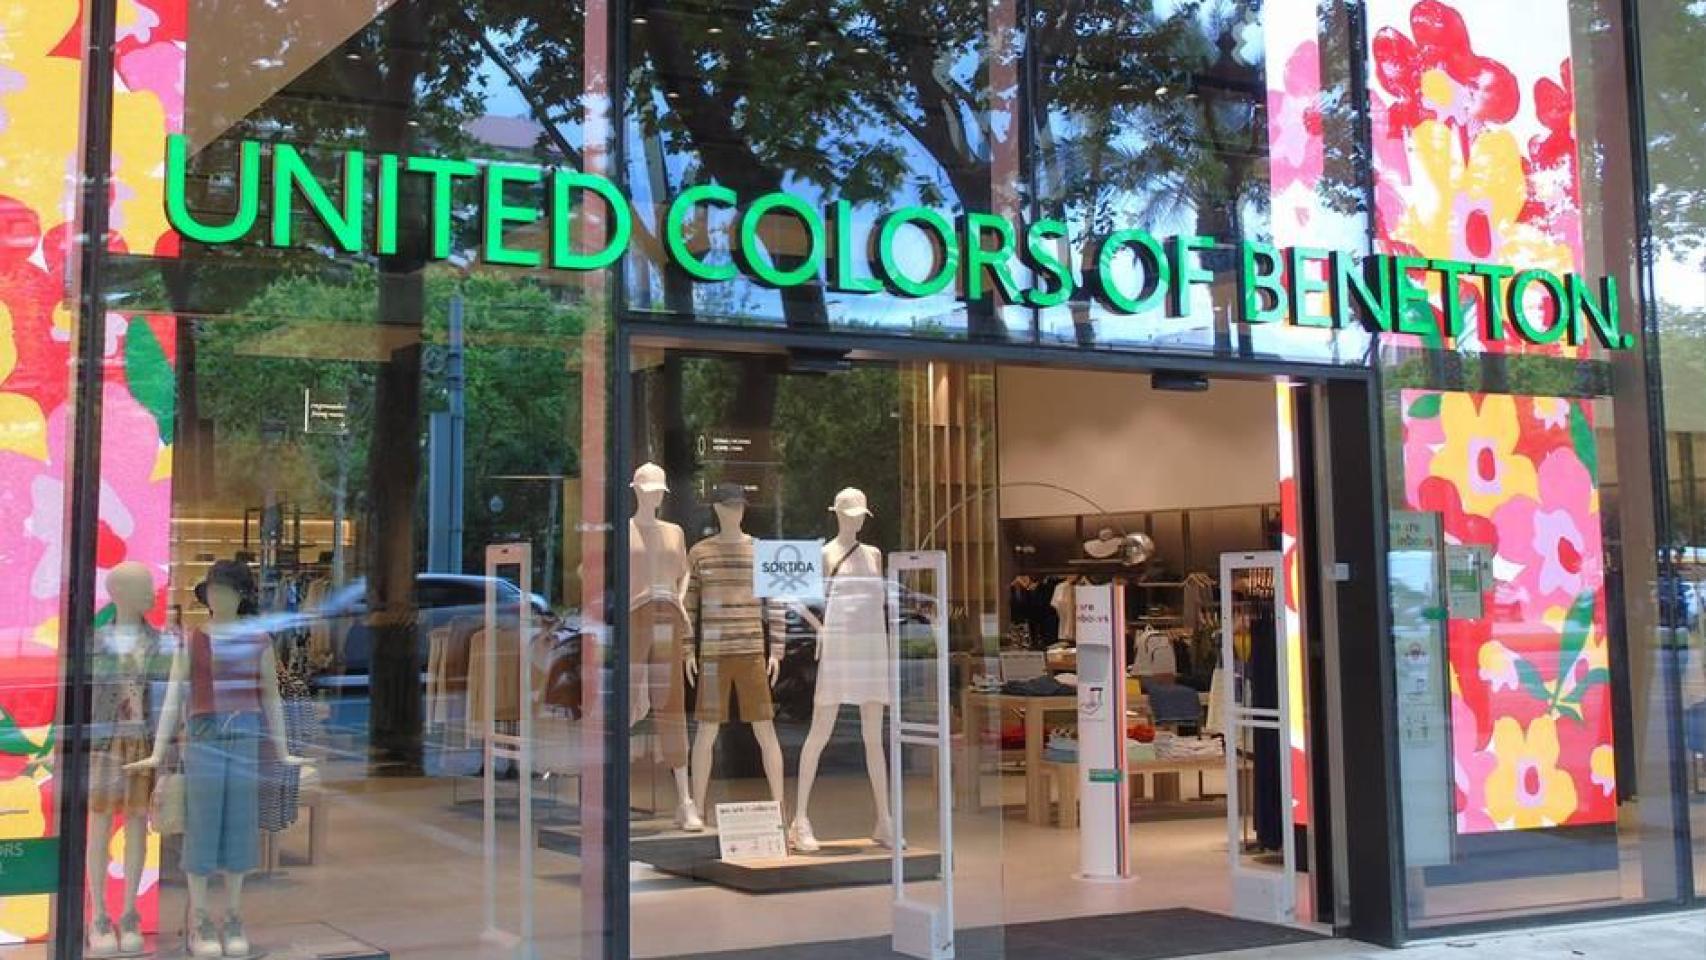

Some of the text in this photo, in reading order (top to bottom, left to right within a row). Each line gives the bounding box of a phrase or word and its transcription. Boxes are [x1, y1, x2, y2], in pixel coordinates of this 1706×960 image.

[165, 134, 1635, 349] UNITED COLORS OF BENETTON.
[761, 560, 815, 574] SORTIDA
